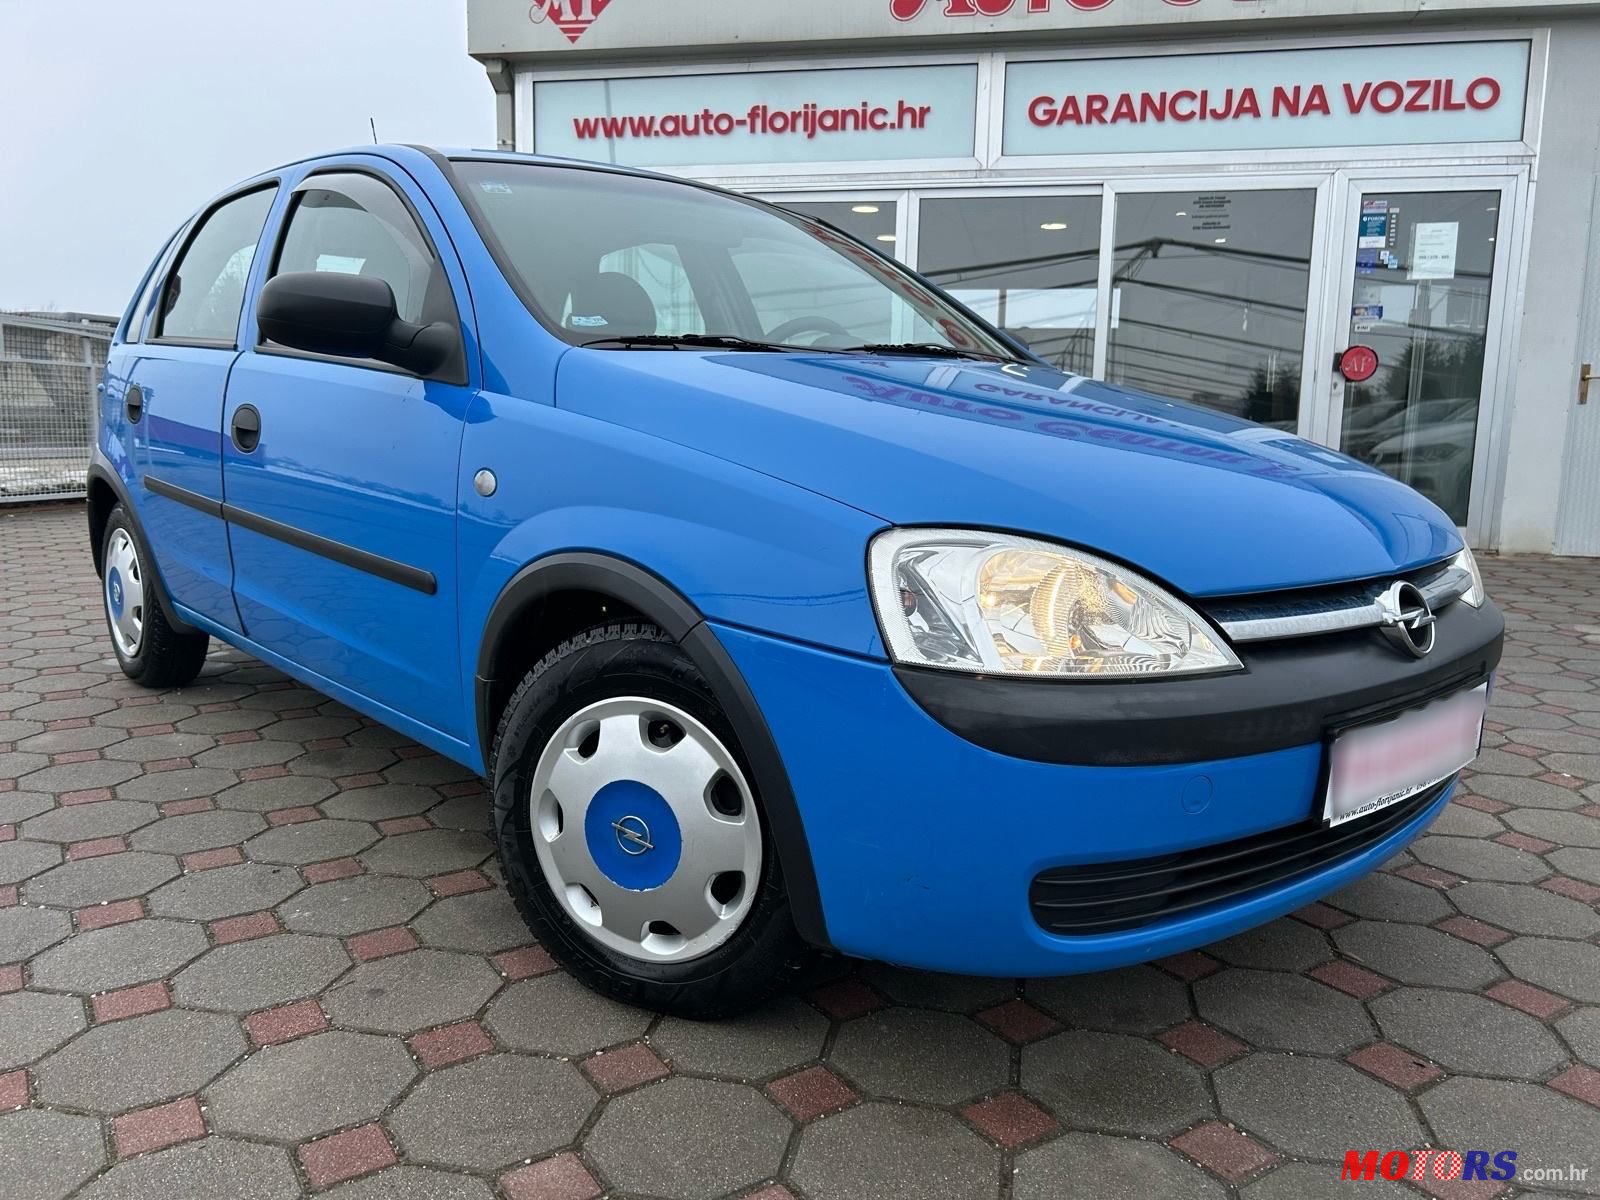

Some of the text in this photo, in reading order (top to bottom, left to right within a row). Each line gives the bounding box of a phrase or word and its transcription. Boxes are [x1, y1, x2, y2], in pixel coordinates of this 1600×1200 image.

[573, 100, 931, 139] www.auto-florijanic.hr
[1027, 77, 1501, 126] GARANCIJA NA VOZILO
